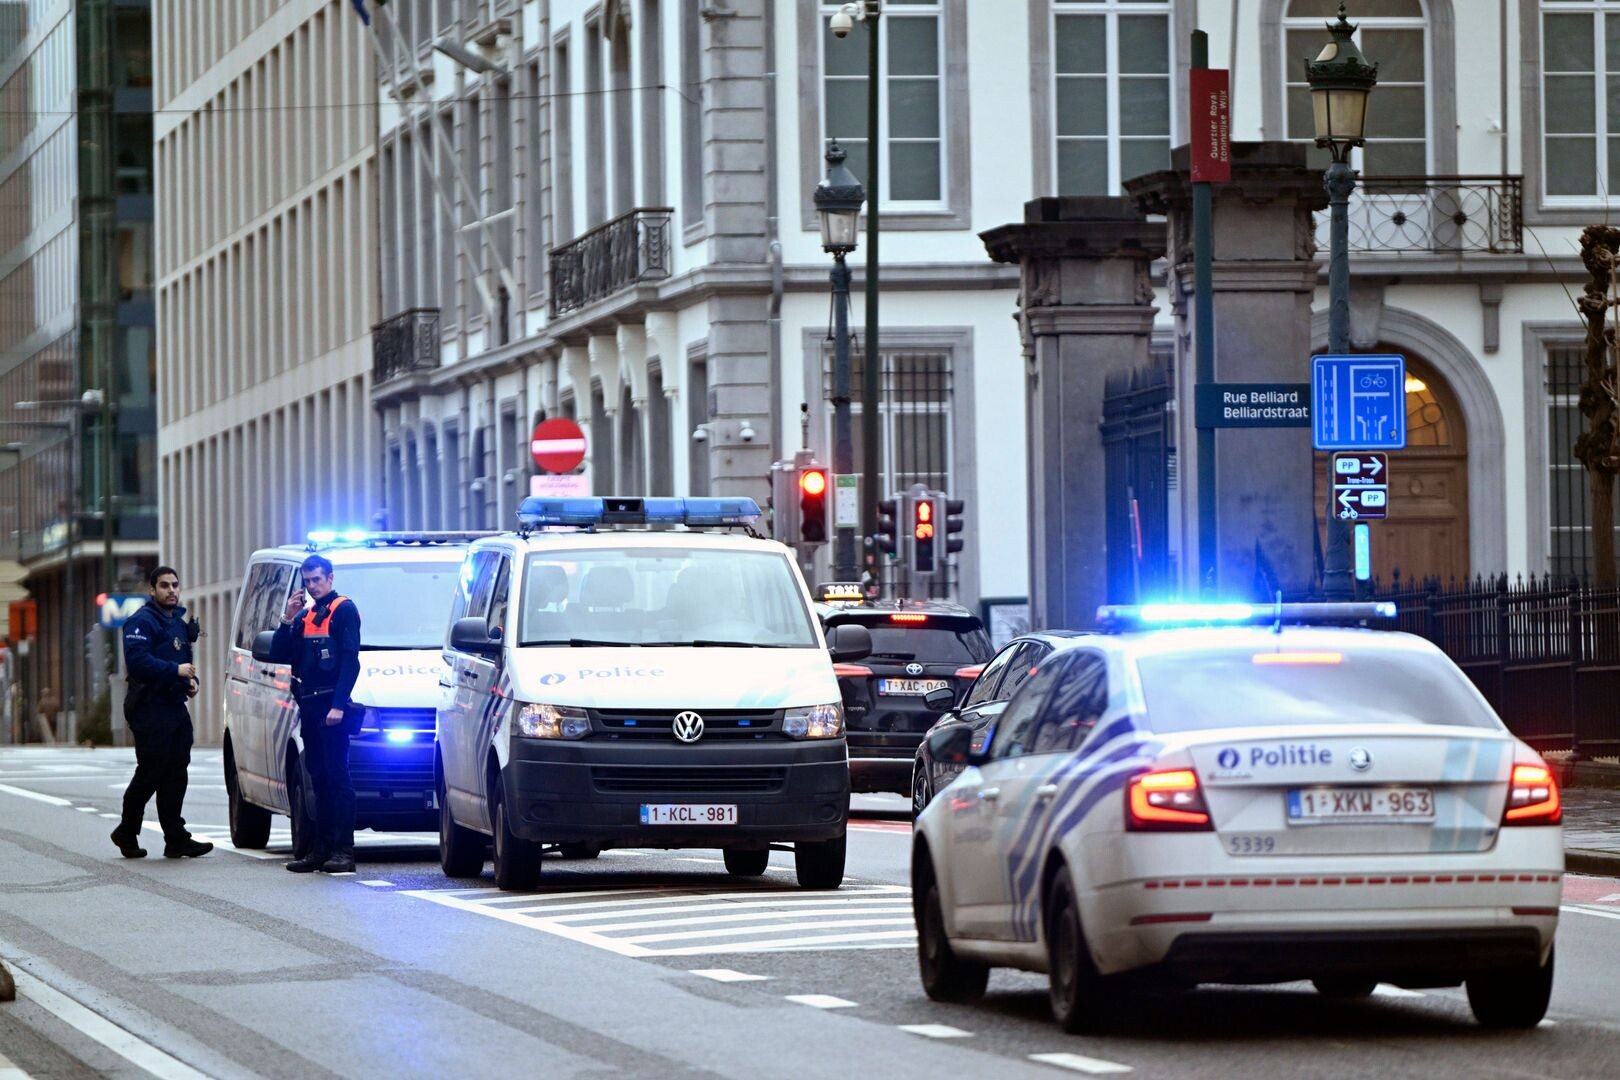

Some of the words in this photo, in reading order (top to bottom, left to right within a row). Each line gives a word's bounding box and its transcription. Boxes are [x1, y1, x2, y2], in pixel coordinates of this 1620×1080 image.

[1210, 92, 1218, 116] Royal
[1220, 90, 1228, 109] Wijk
[1210, 120, 1218, 159] Quartier
[1220, 115, 1228, 162] Koninklijke
[1223, 392, 1248, 403] Rue
[1250, 391, 1298, 403] Belliard
[1223, 406, 1309, 418] Belliardstraat
[1342, 461, 1354, 470] PP
[1367, 494, 1379, 503] PP
[827, 585, 859, 594] TAXI
[367, 665, 442, 678] Police
[578, 665, 665, 680] Police
[1251, 745, 1332, 767] Politie
[1304, 792, 1431, 814] 1-XKW-963
[652, 807, 734, 821] 1-KCL-981
[1230, 836, 1276, 852] 5339
